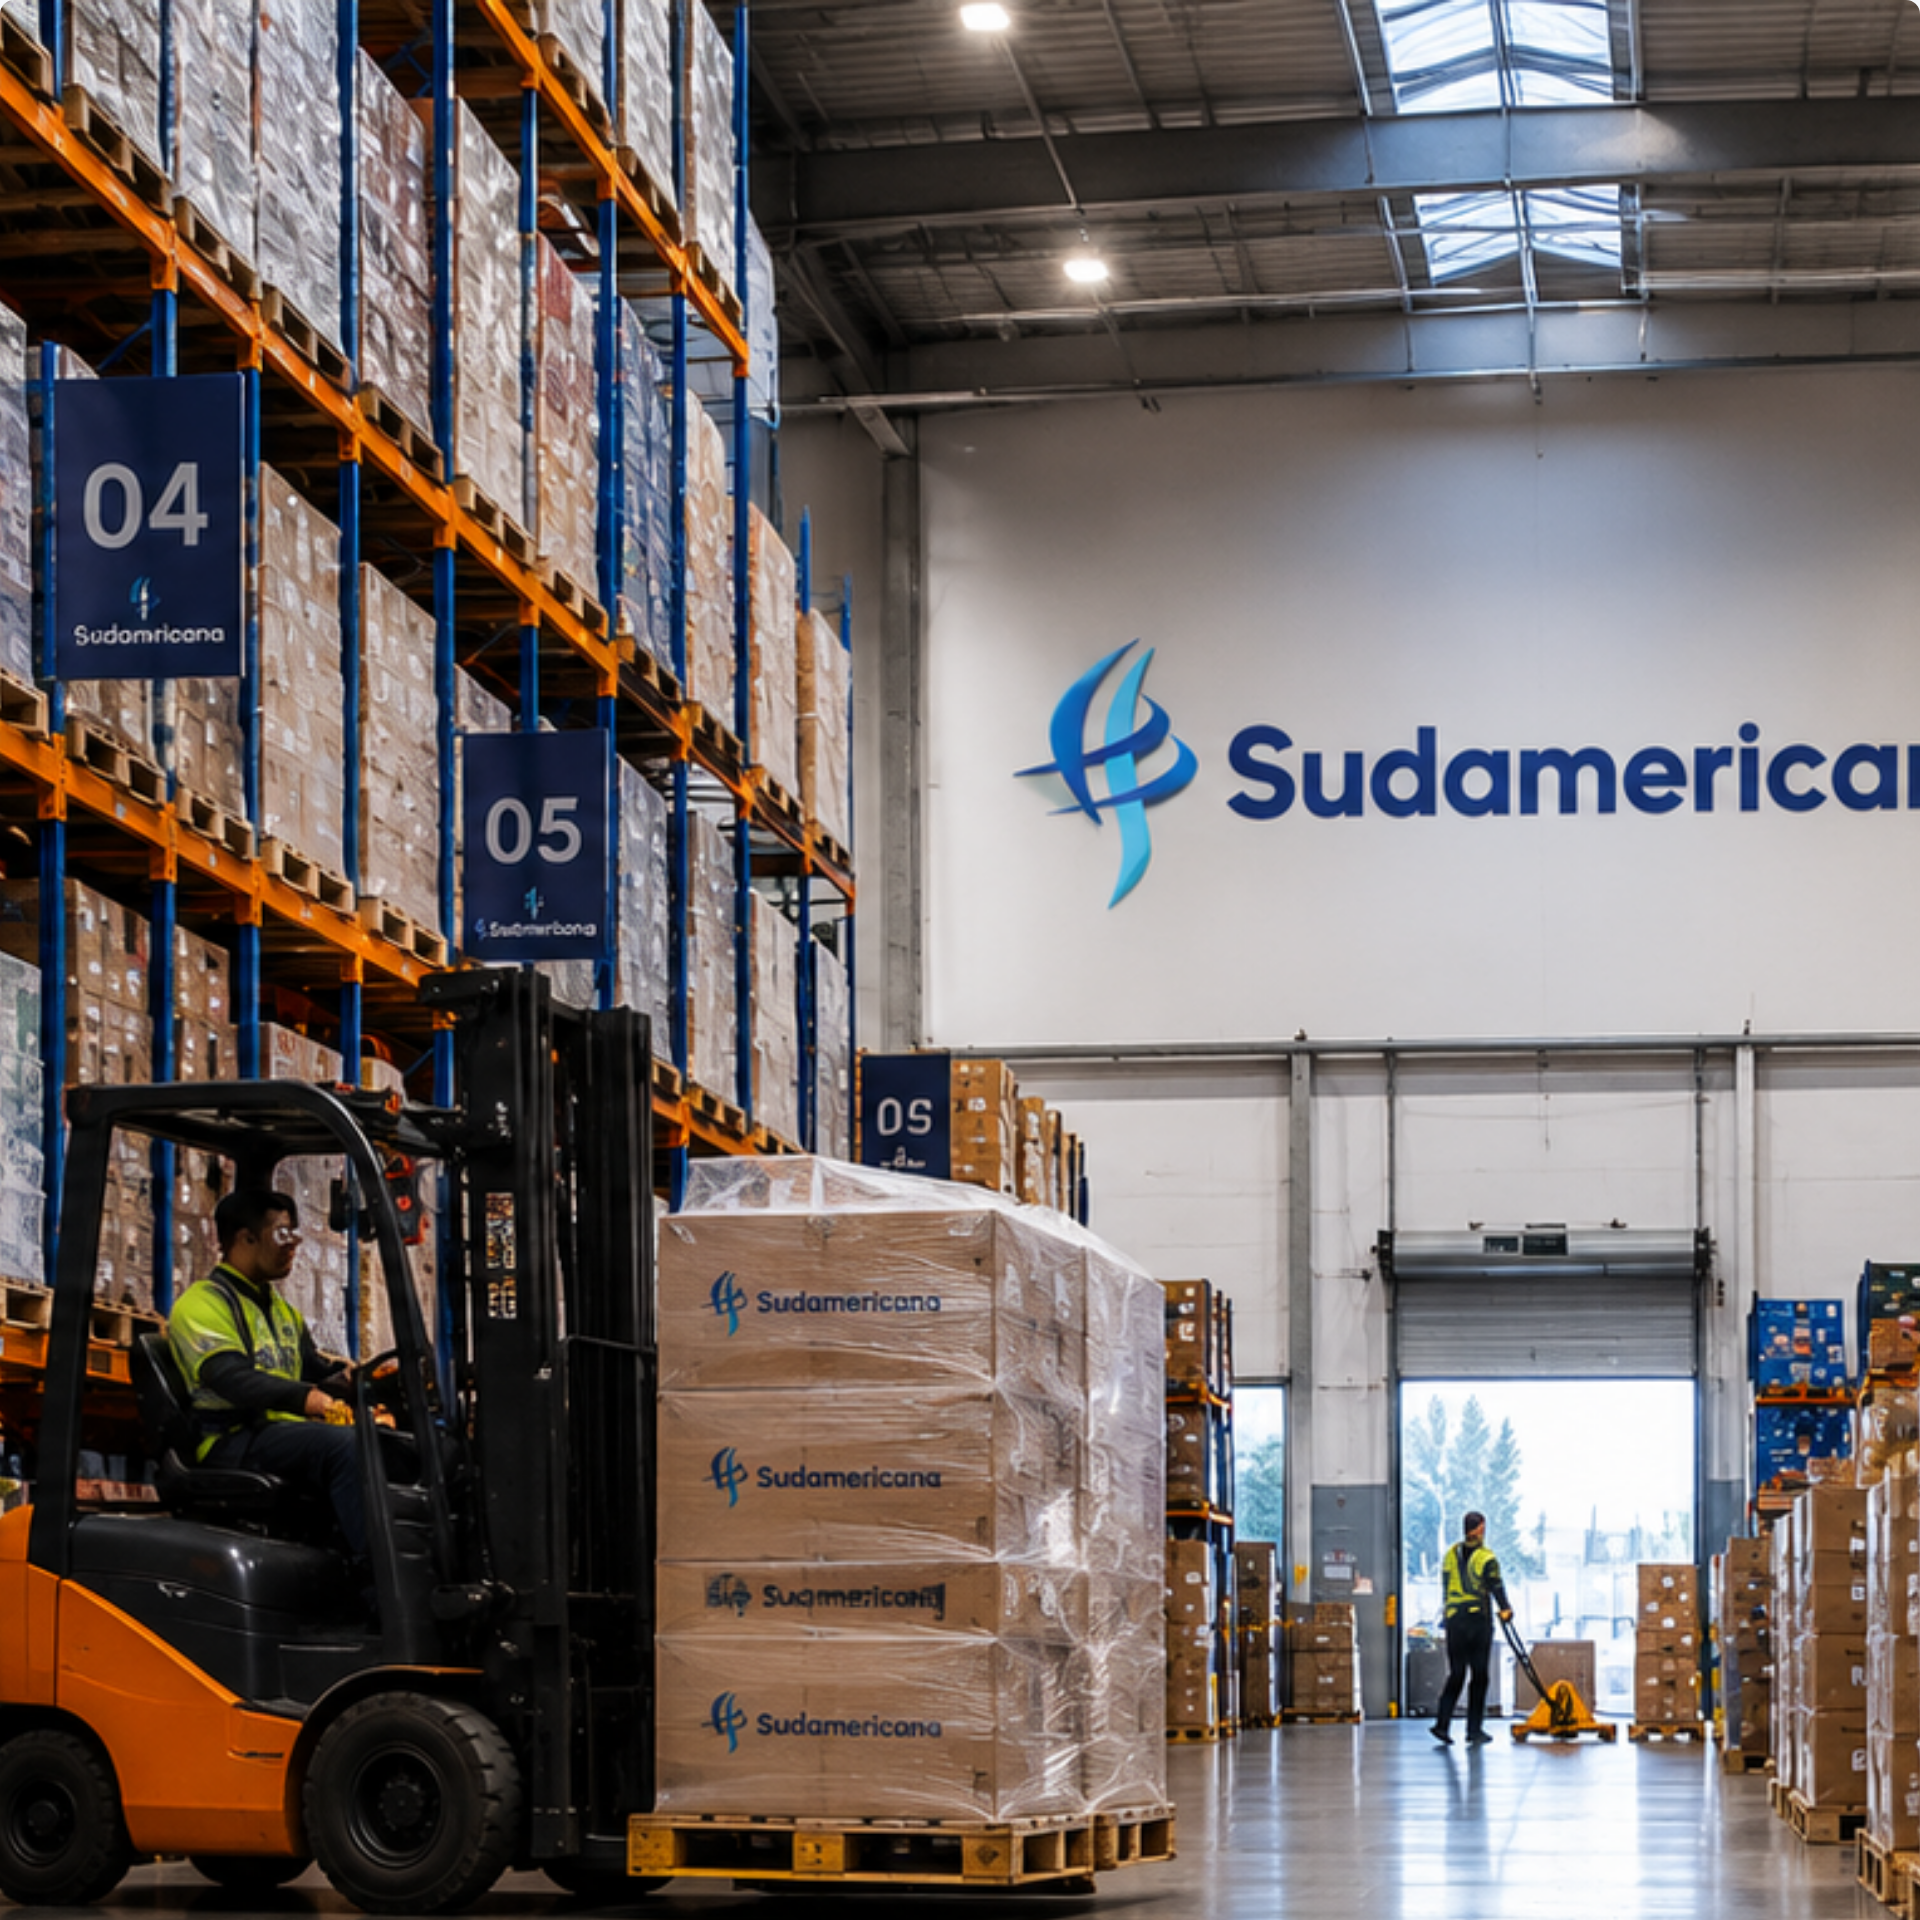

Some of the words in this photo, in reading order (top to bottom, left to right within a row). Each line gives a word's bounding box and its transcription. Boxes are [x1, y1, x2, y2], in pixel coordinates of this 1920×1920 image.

[83, 462, 208, 549] 04
[1226, 721, 1920, 821] Sudamerica
[485, 797, 582, 864] 05
[757, 1465, 941, 1489] Sudamericana
